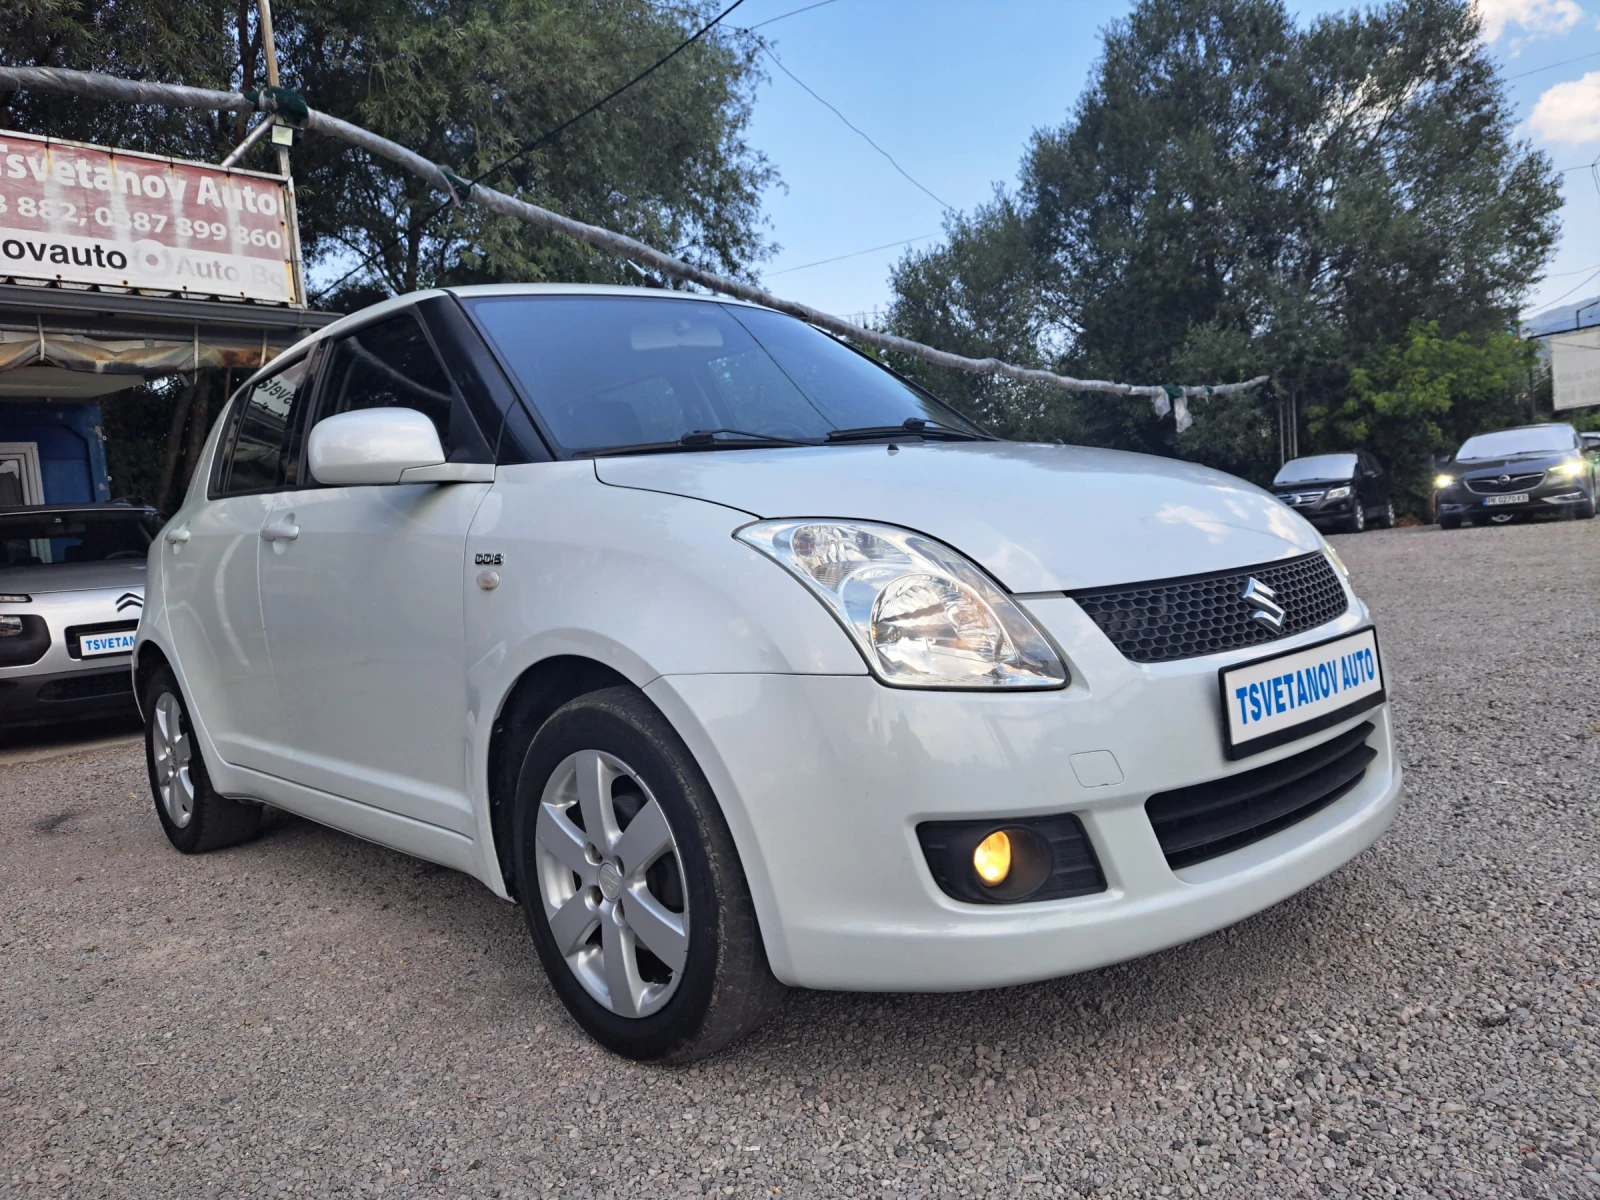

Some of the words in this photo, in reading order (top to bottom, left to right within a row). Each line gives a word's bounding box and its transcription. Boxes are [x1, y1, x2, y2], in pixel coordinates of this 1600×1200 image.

[197, 176, 278, 216] Auto
[175, 217, 227, 241] 899
[2, 239, 128, 270] ovauto
[1235, 659, 1339, 725] TSVETANOV
[1341, 647, 1375, 690] AUTO
